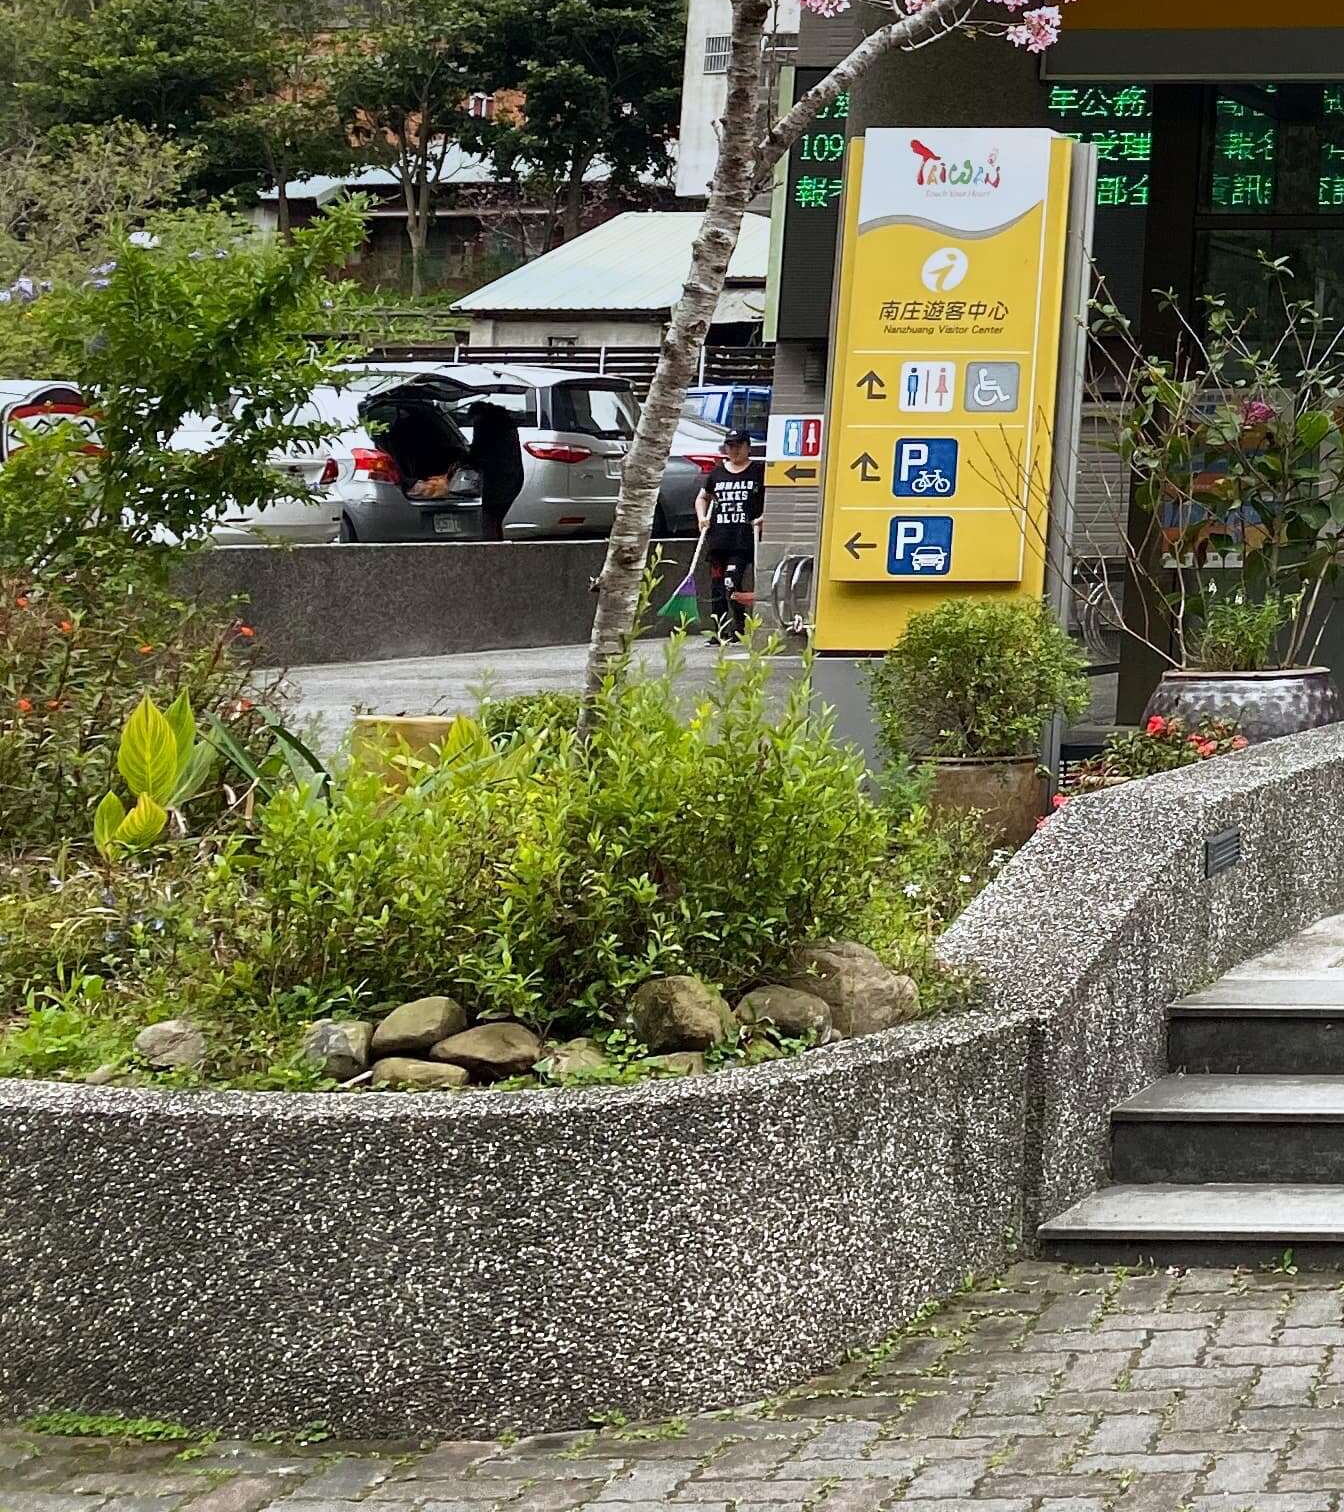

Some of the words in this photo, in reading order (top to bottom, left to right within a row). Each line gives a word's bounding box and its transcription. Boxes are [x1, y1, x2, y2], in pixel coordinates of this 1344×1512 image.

[1048, 85, 1152, 117] 年公務
[800, 134, 845, 162] 109
[878, 300, 1009, 321] 南庄遊客中心
[884, 325, 935, 336] Nanzhuang
[938, 325, 969, 335] Visitor
[971, 325, 1004, 335] Center
[900, 443, 929, 482] P
[895, 521, 924, 560] P
